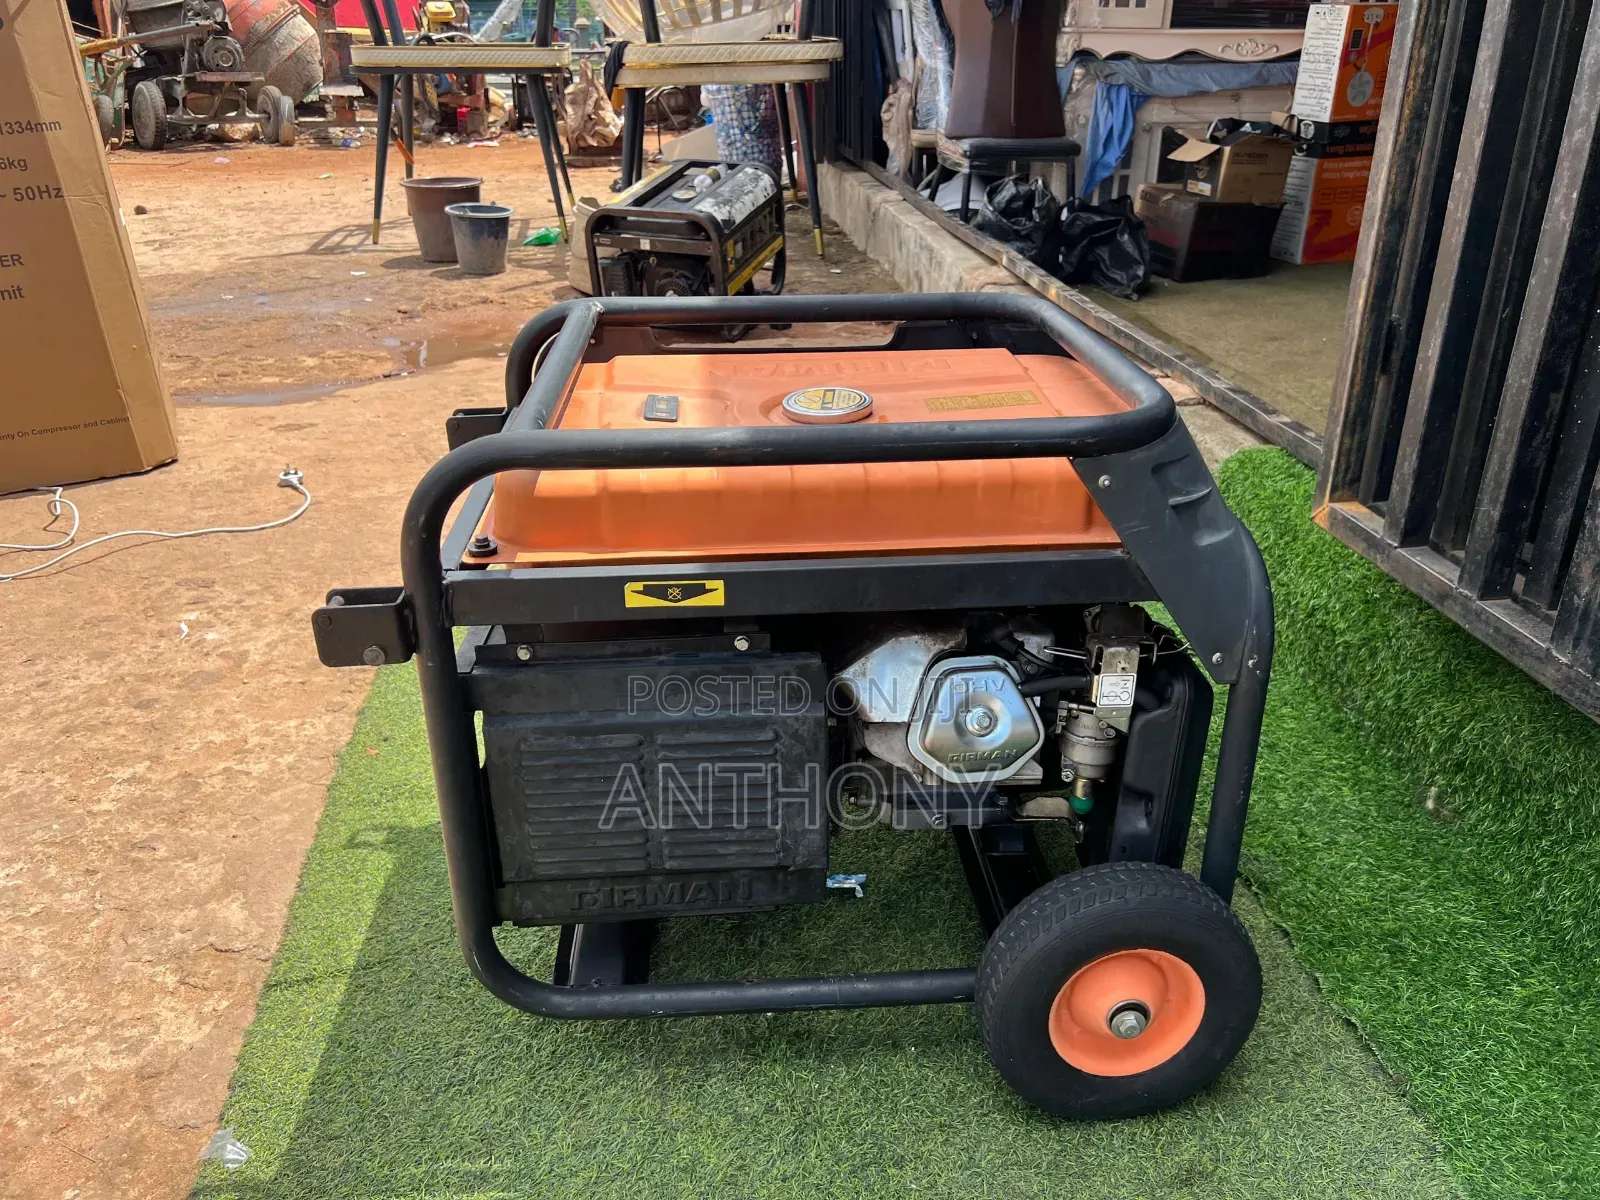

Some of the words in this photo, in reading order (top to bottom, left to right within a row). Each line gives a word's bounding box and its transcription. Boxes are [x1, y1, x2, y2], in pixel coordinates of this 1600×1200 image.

[13, 184, 64, 202] 50Hz
[0, 253, 25, 267] ER
[17, 430, 30, 438] On
[31, 423, 81, 436] Compressor
[83, 420, 98, 429] and
[100, 415, 130, 426] Cabinet
[569, 877, 750, 912] FIRMAN
